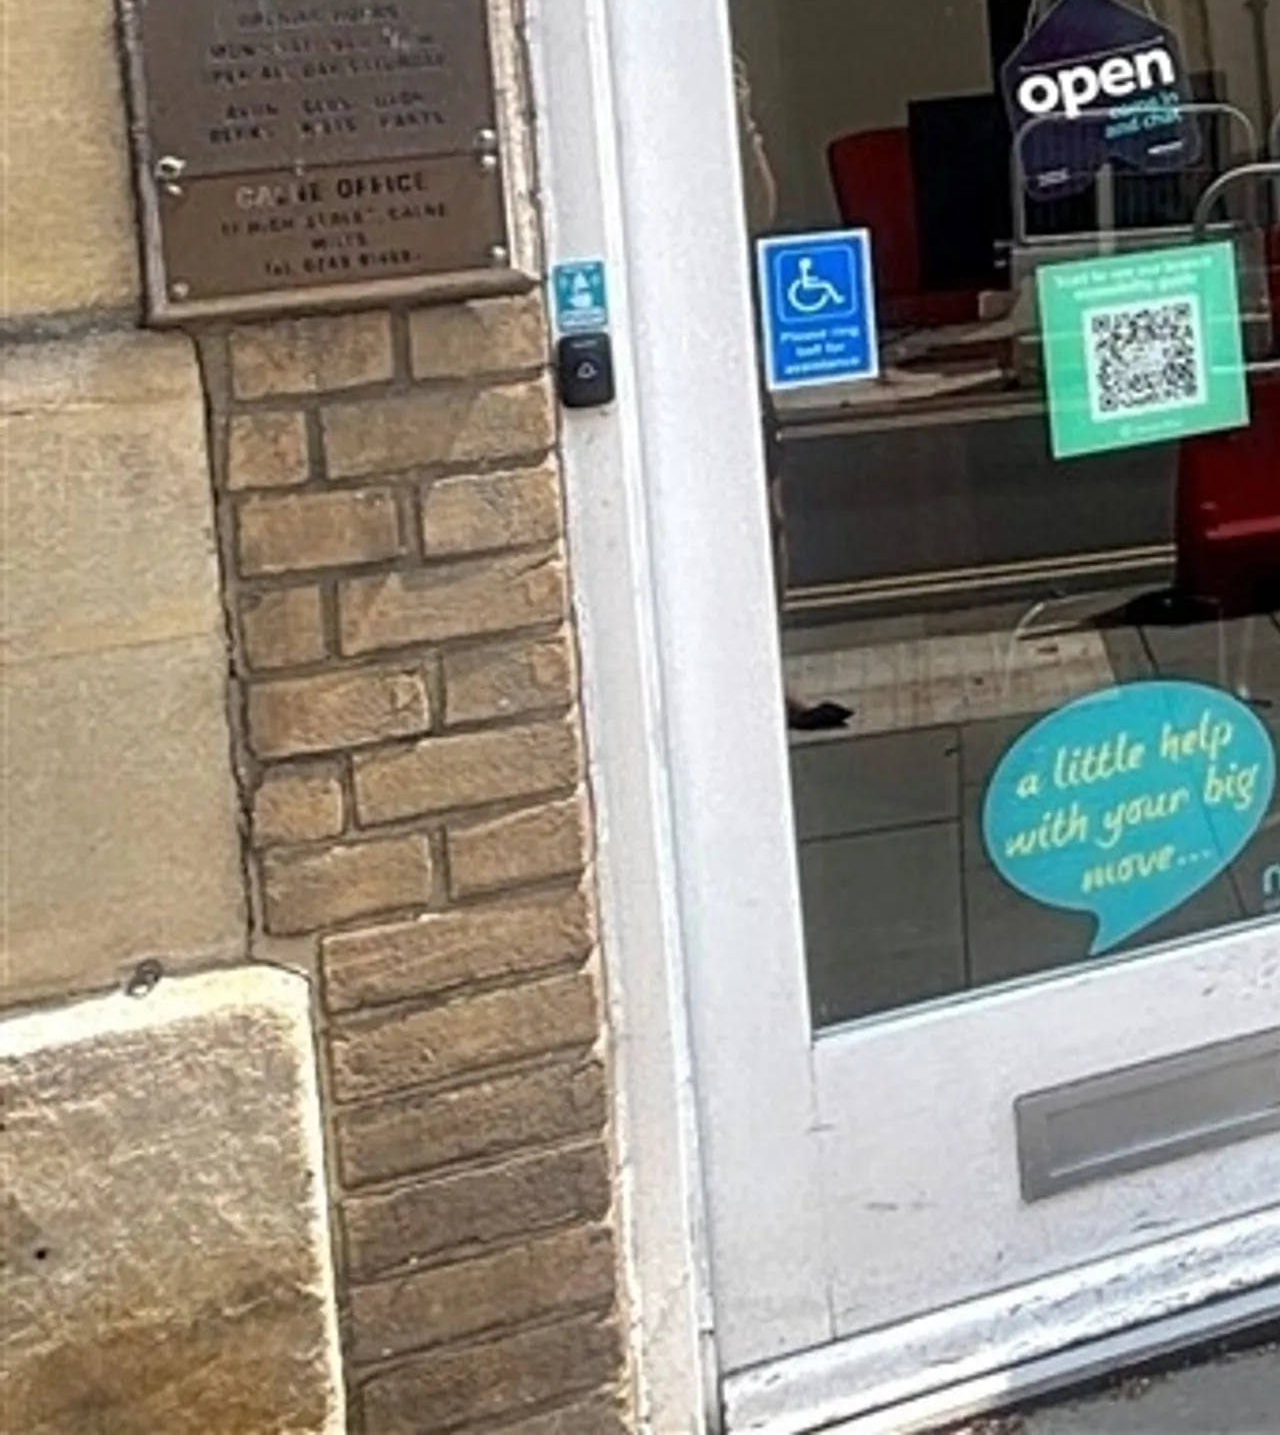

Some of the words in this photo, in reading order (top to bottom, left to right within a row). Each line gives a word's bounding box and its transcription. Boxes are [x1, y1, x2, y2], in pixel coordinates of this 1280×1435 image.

[1017, 46, 1176, 120] open
[1015, 774, 1043, 799] a
[1053, 730, 1146, 789] little
[1159, 709, 1235, 762] help
[1004, 803, 1089, 858] with
[1094, 789, 1190, 849] your
[1203, 761, 1261, 812] big
